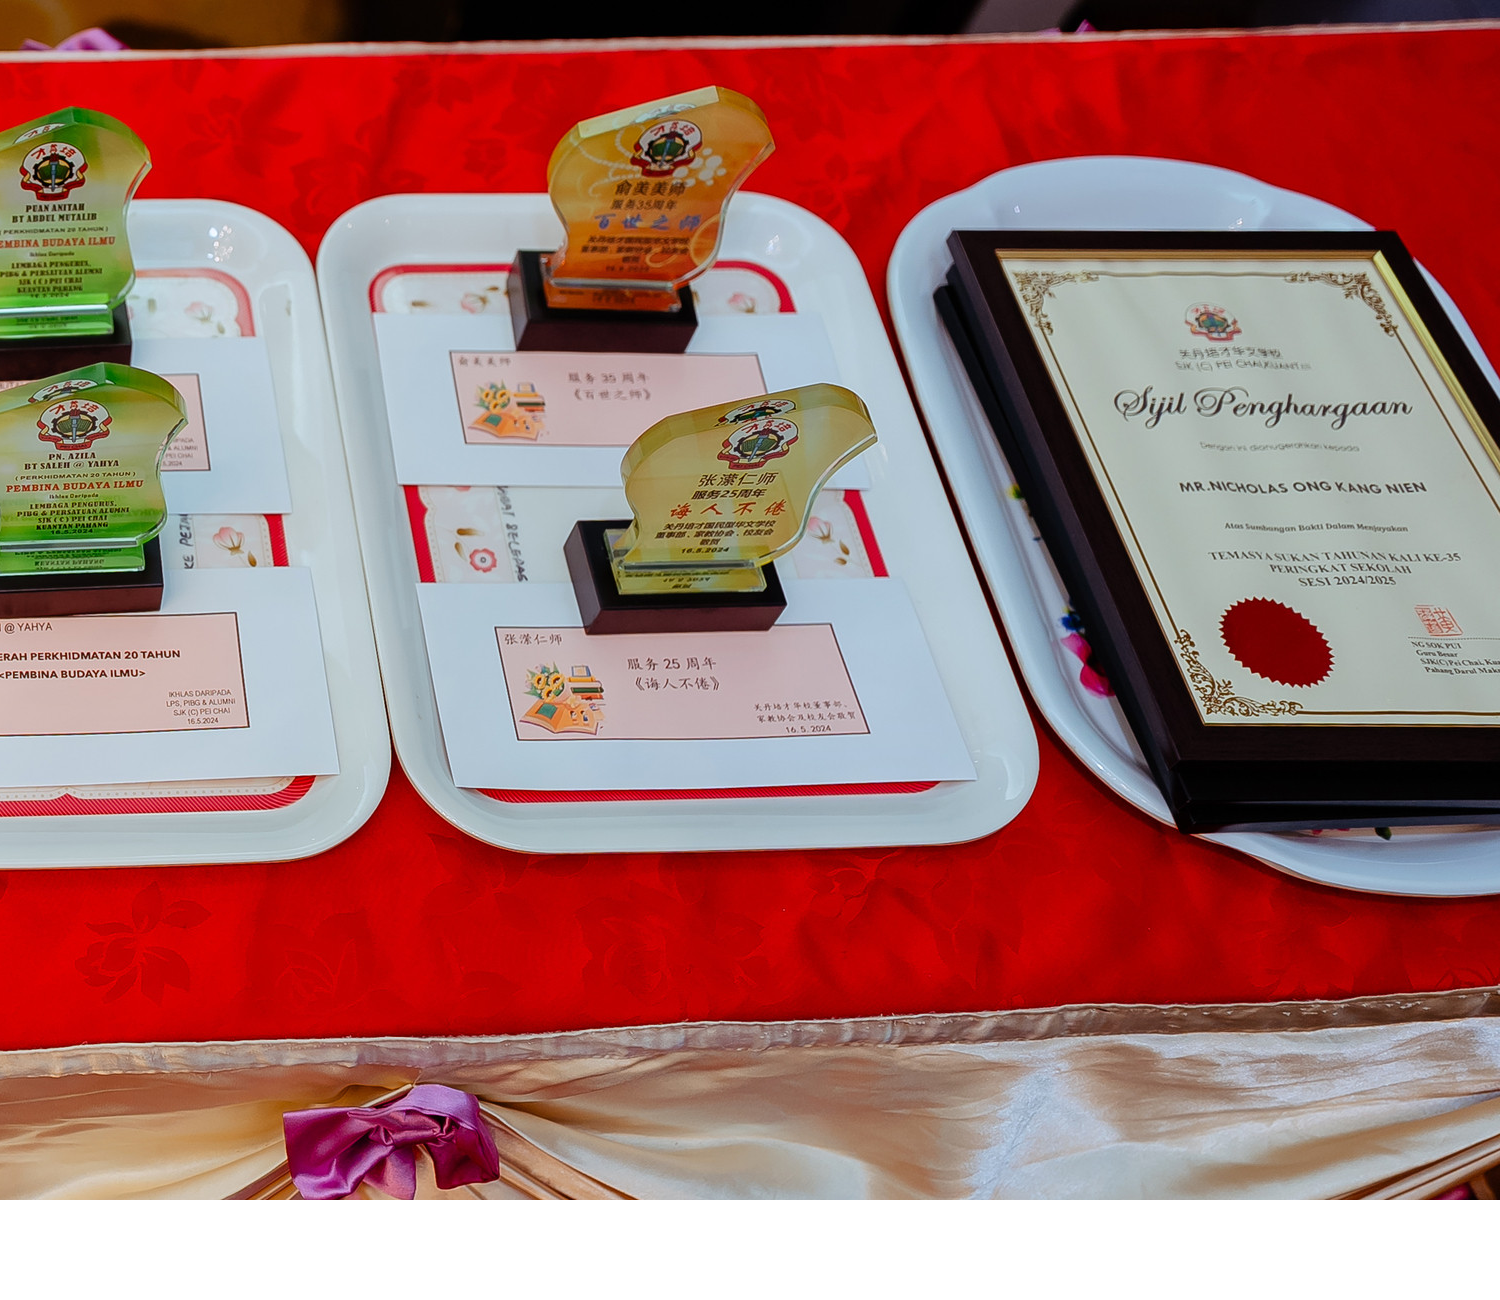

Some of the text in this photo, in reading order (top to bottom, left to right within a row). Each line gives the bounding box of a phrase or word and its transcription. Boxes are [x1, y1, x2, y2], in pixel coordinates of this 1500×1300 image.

[25, 203, 85, 213] PUAN ANITAH
[12, 212, 98, 223] BT ABDUL MUTALIB
[42, 237, 86, 247] BUDAYA
[88, 236, 116, 246] ILMU
[1113, 385, 1414, 431] Sijil Penghargaan
[48, 452, 97, 461] PN. AZILA
[24, 460, 120, 471] BT SALEH @ YAHYA
[6, 480, 144, 493] PEMBINA BUDAYA ILMU
[1179, 480, 1428, 494] MR.NICHOLAS ONG KANG NIEN
[691, 488, 768, 500] 服务25周年
[50, 508, 97, 516] PERSATUAN
[670, 498, 787, 520] 诲人不倦
[1224, 522, 1244, 530] Atas
[1245, 523, 1297, 534] Sumbangan
[1325, 522, 1356, 531] Dalam
[1357, 523, 1409, 533] Menjayakan
[1208, 551, 1462, 563] TEMASYA SUKAN TAHUNAN KALI KE-35
[1269, 563, 1412, 574] PERINGKAT SEKOLAH
[1298, 576, 1397, 587] SESI 2024/2025
[4, 623, 16, 635] @
[16, 622, 53, 632] YAHYA
[1425, 641, 1444, 649] SOK
[30, 651, 121, 661] PERKHIDMATAN
[124, 651, 139, 659] 20
[140, 650, 181, 659] TAHUN
[1416, 649, 1437, 657] Guru
[627, 656, 717, 671] 服务 25 周年
[60, 670, 108, 679] BUDAYA
[110, 669, 146, 678] ILMU>
[1455, 666, 1477, 675] Darul
[195, 689, 232, 697] DARIPADA
[166, 700, 182, 708] LPS,
[208, 698, 236, 706] ALUMNI
[187, 717, 219, 725] 16.5.2024
